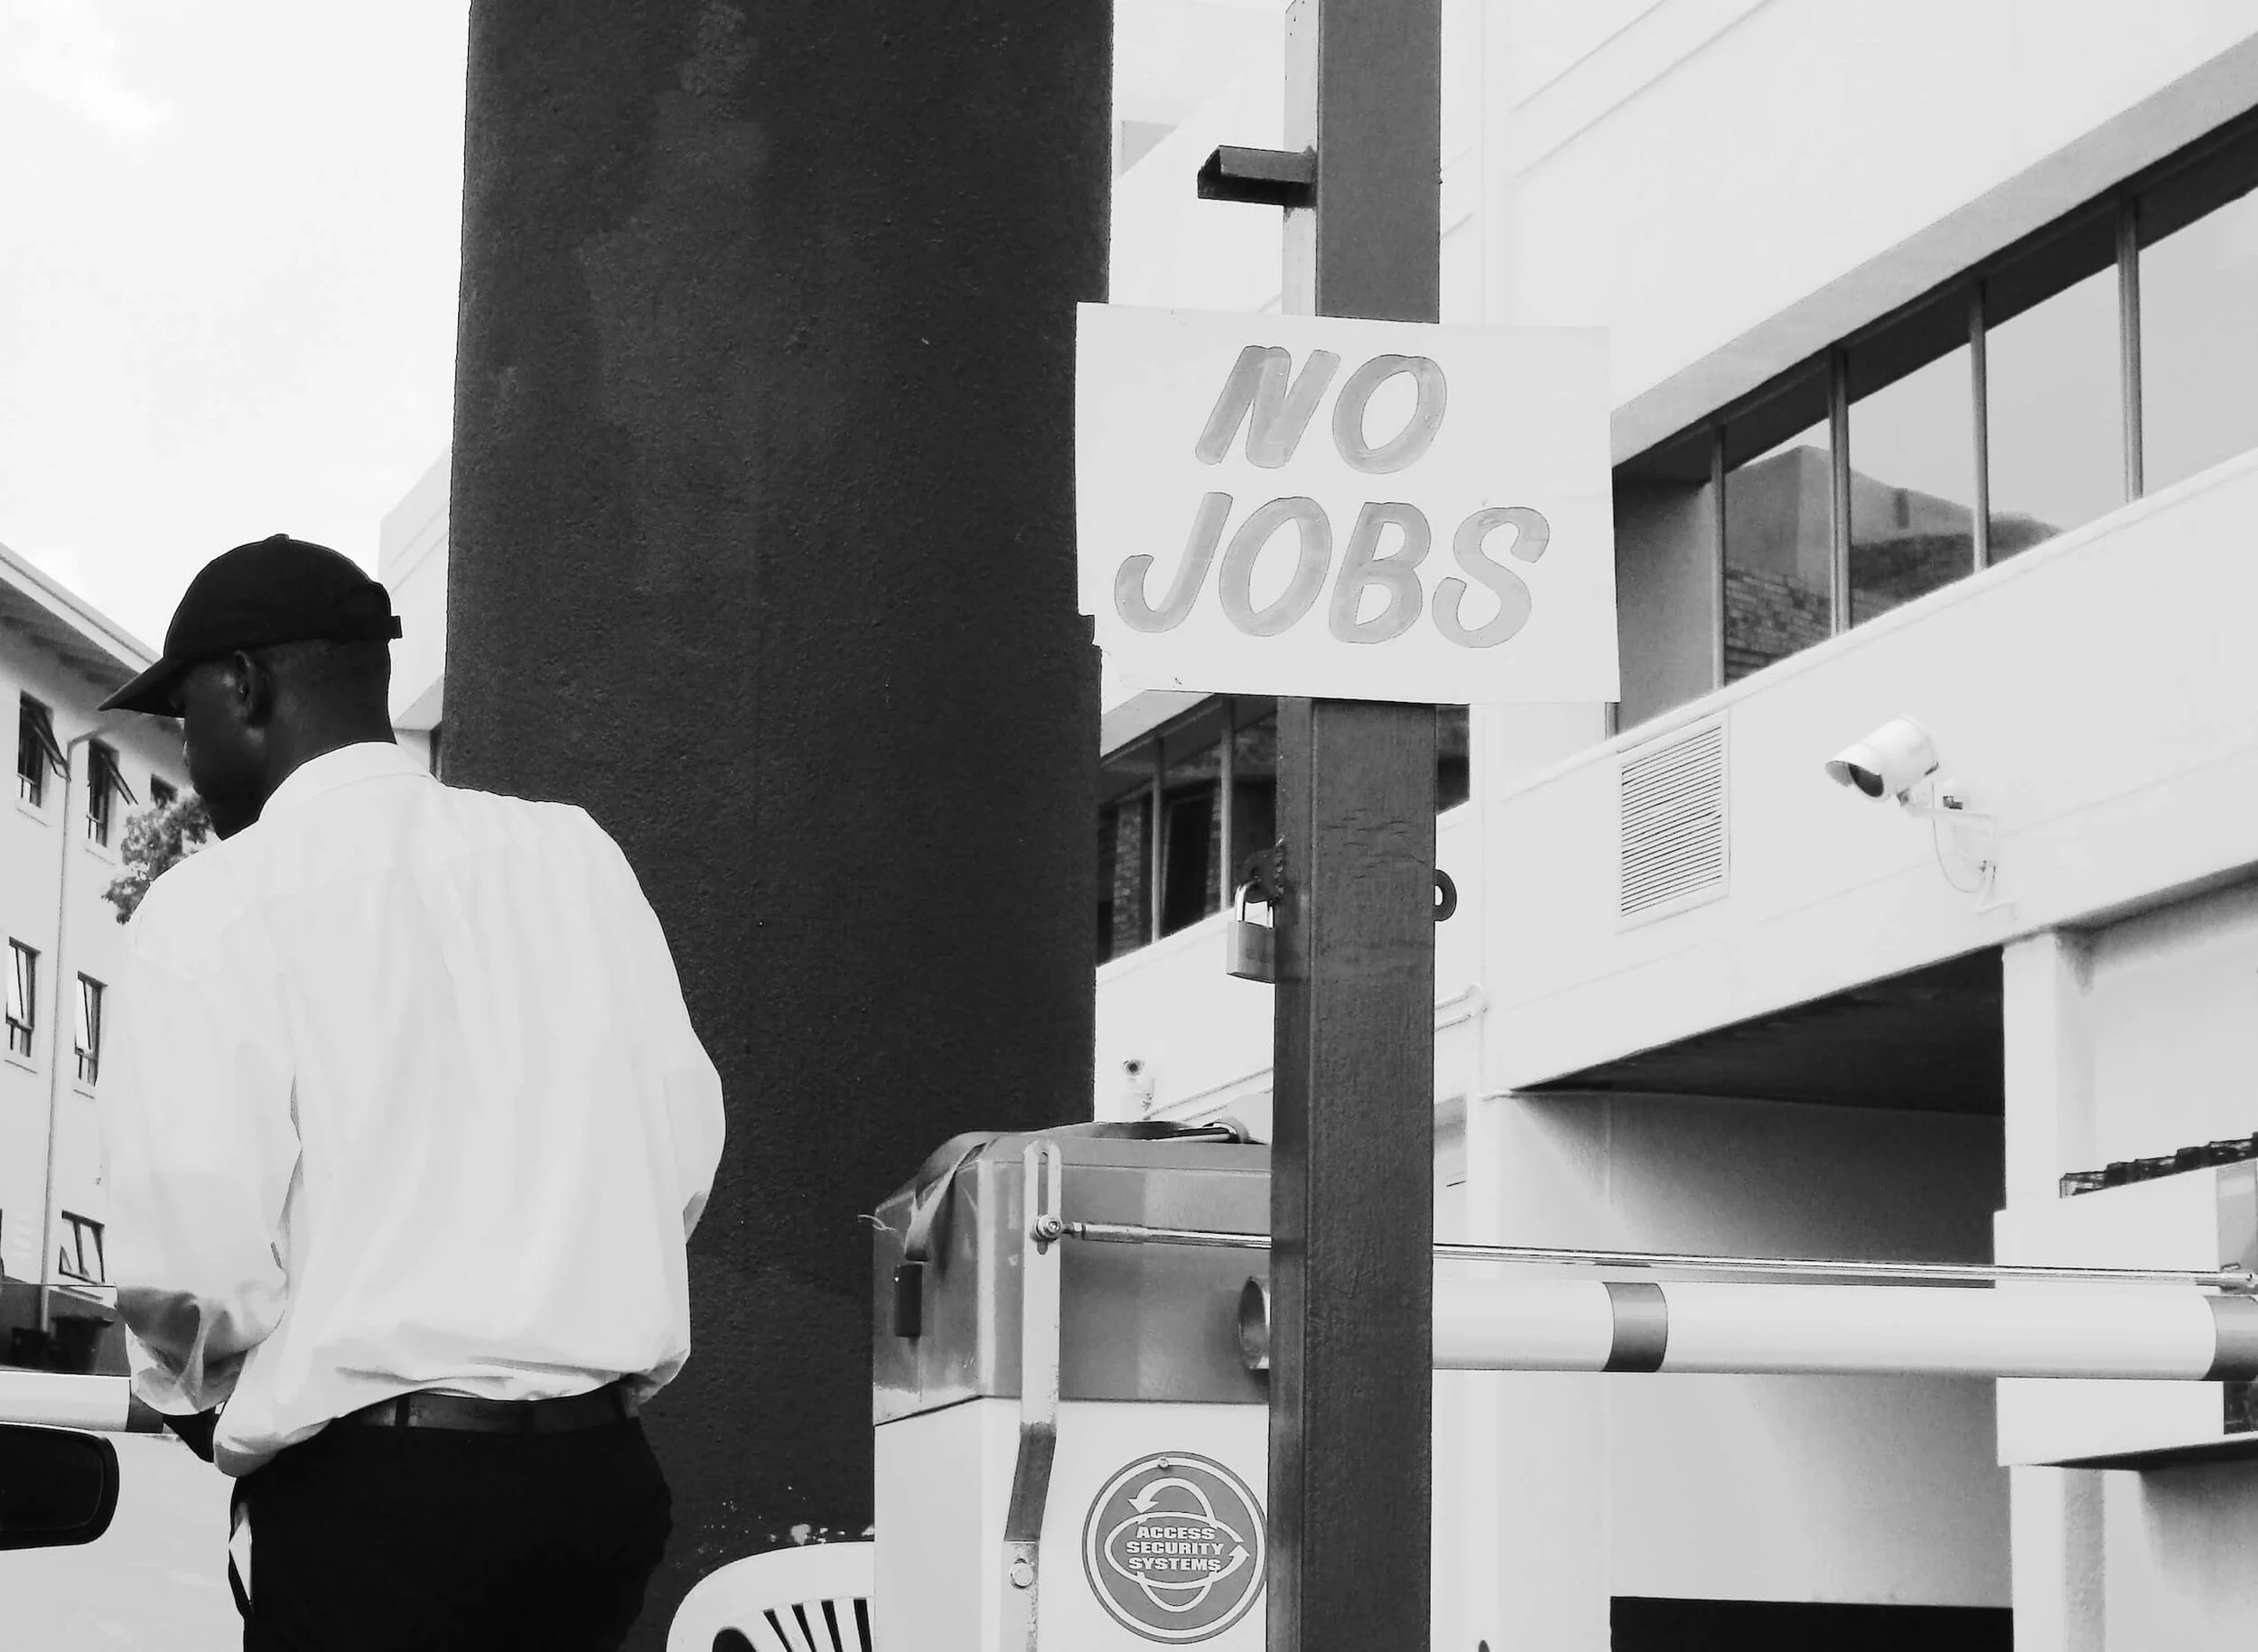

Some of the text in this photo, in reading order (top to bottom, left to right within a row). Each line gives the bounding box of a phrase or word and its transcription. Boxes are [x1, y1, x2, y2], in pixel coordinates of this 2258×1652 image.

[1195, 345, 1447, 474] NO
[1115, 492, 1550, 648] JOBS
[1136, 1526, 1216, 1540] ACCESS
[1126, 1541, 1225, 1555] SECURITY
[1128, 1557, 1221, 1572] SYSTEMS
